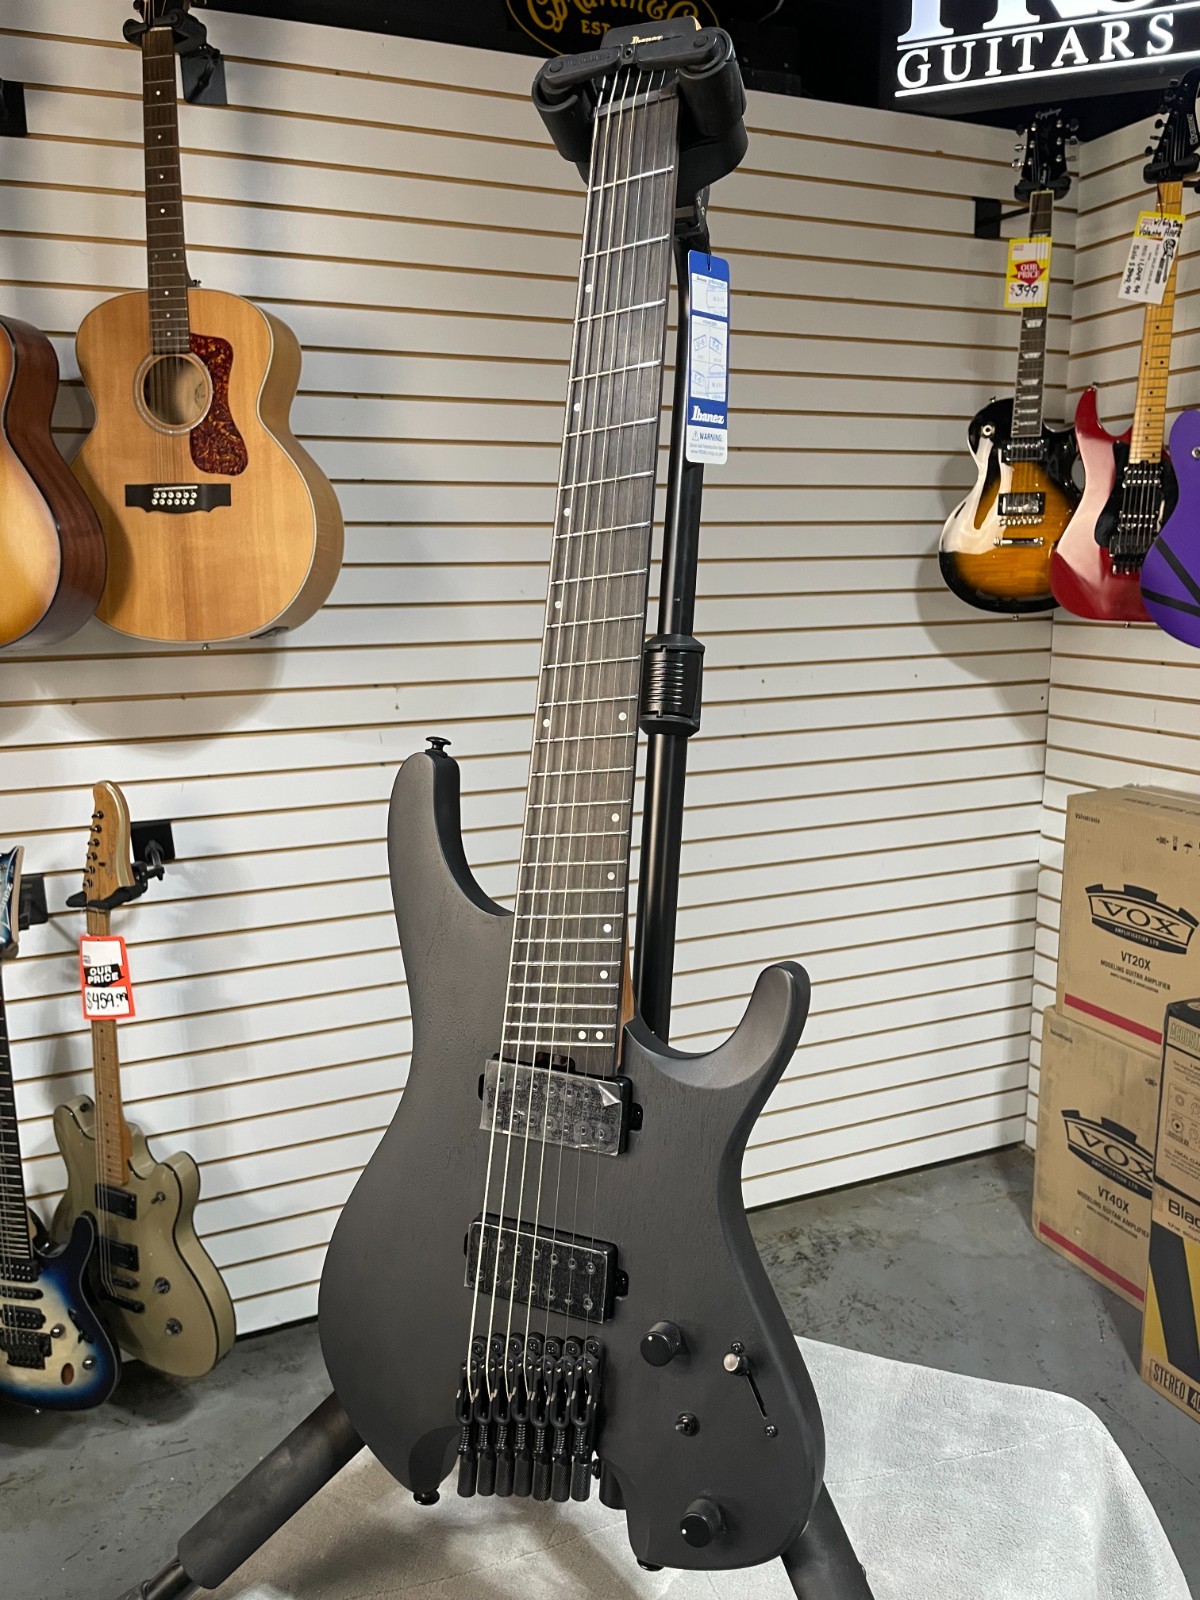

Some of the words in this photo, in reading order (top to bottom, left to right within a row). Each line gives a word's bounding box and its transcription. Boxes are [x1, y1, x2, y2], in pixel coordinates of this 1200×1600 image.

[630, 35, 664, 45] Ibanez
[896, 12, 1175, 89] GUITARS
[1020, 263, 1038, 272] OUR
[691, 405, 725, 425] Ibanez
[1098, 899, 1180, 938] VOX
[1114, 927, 1149, 944] AMPLIFICATION
[89, 965, 113, 976] OUR
[1121, 950, 1151, 971] VT20X
[87, 972, 119, 985] PRICE
[1100, 959, 1125, 974] MODELING
[1125, 968, 1144, 980] GUITAR
[1144, 975, 1171, 991] AMPLIFIER
[1074, 1125, 1154, 1182] VOX
[1098, 1185, 1129, 1214] VT40X
[1102, 1204, 1122, 1221] GUITAR
[1153, 1363, 1186, 1401] STEREO
